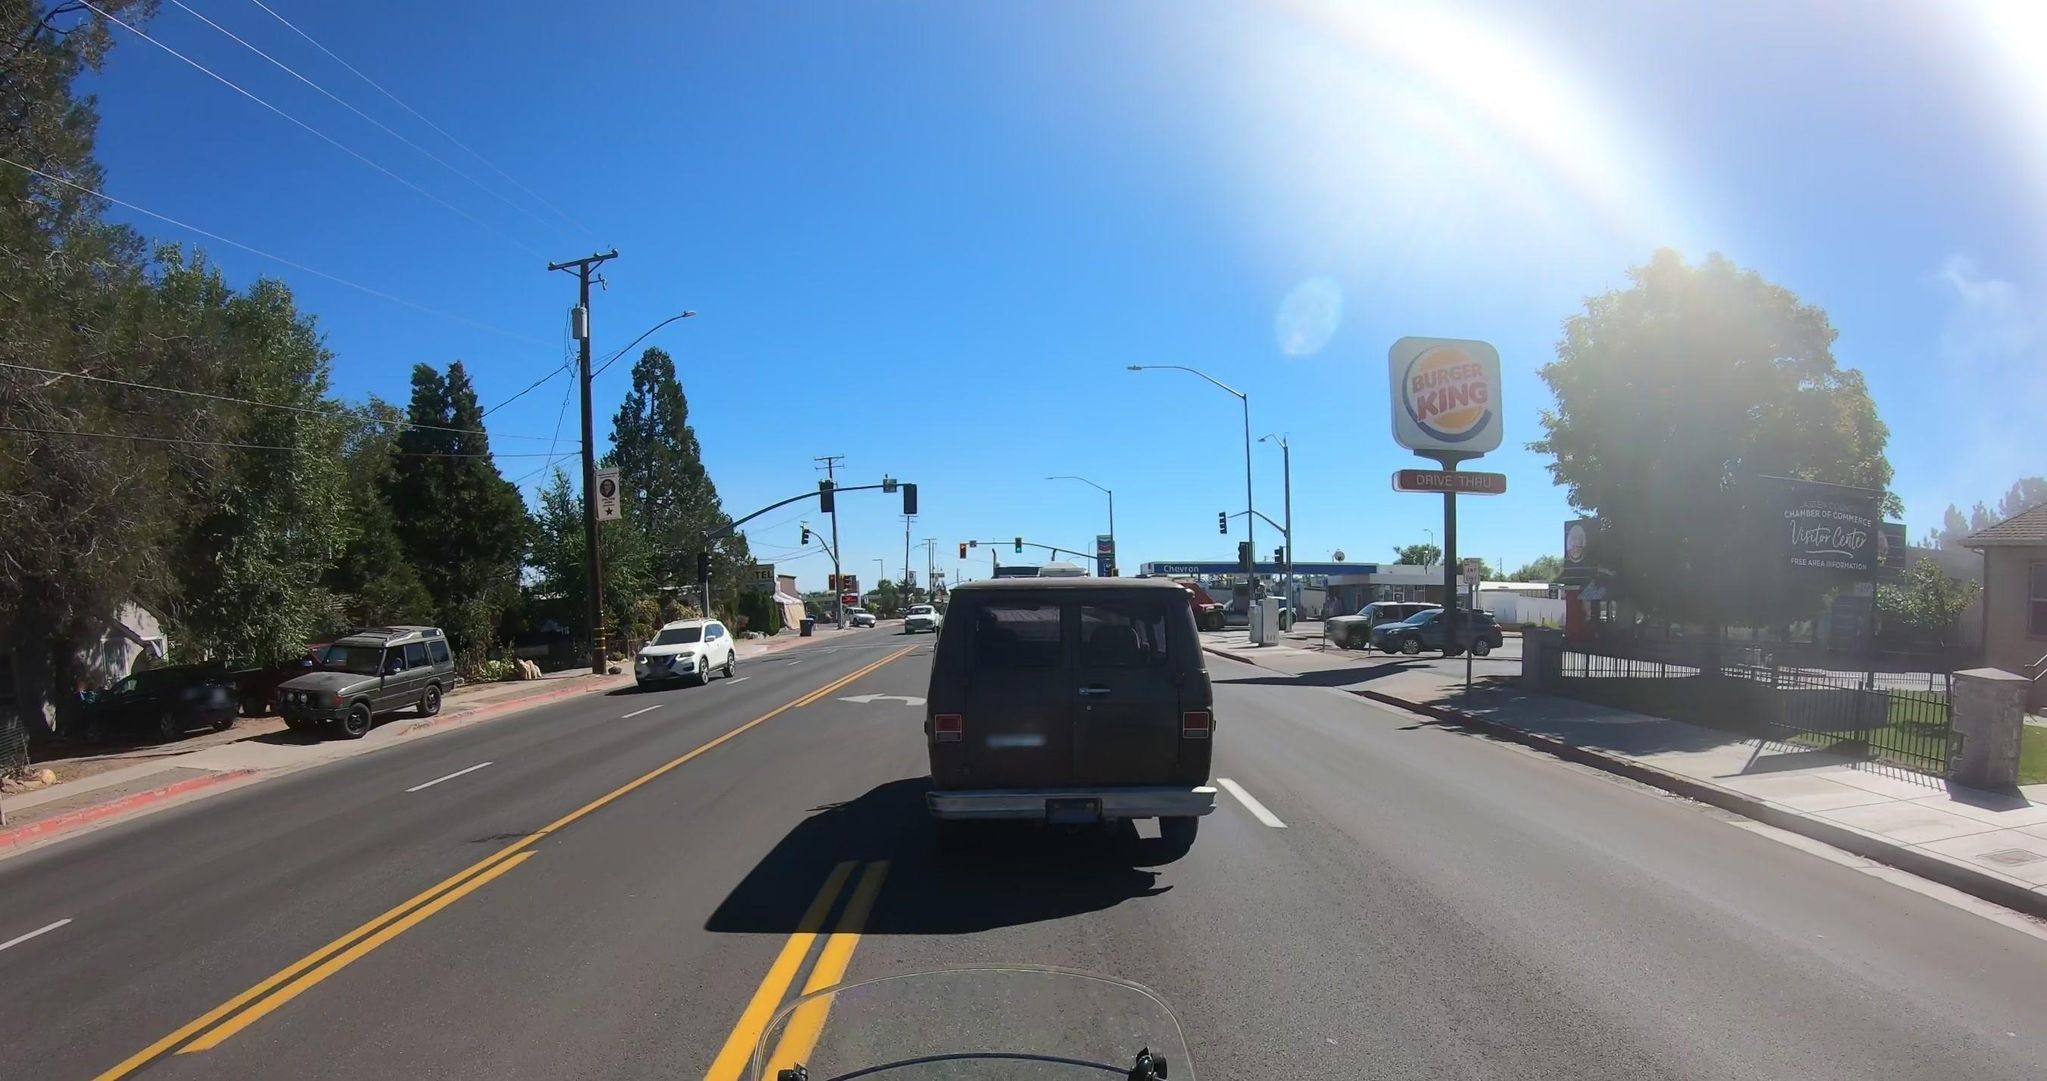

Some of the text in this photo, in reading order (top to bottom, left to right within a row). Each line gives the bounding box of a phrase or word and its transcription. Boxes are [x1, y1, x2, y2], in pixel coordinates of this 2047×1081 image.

[1412, 363, 1483, 394] BURGER
[1416, 381, 1488, 422] KING
[1416, 474, 1491, 488] DRIVE THRU
[1784, 509, 1872, 528] CHAMBER OF COMMERCE
[1790, 519, 1867, 550] Visitor Center
[1163, 564, 1199, 573] Chevron
[1791, 557, 1867, 570] FREE AREA INFORMATION
